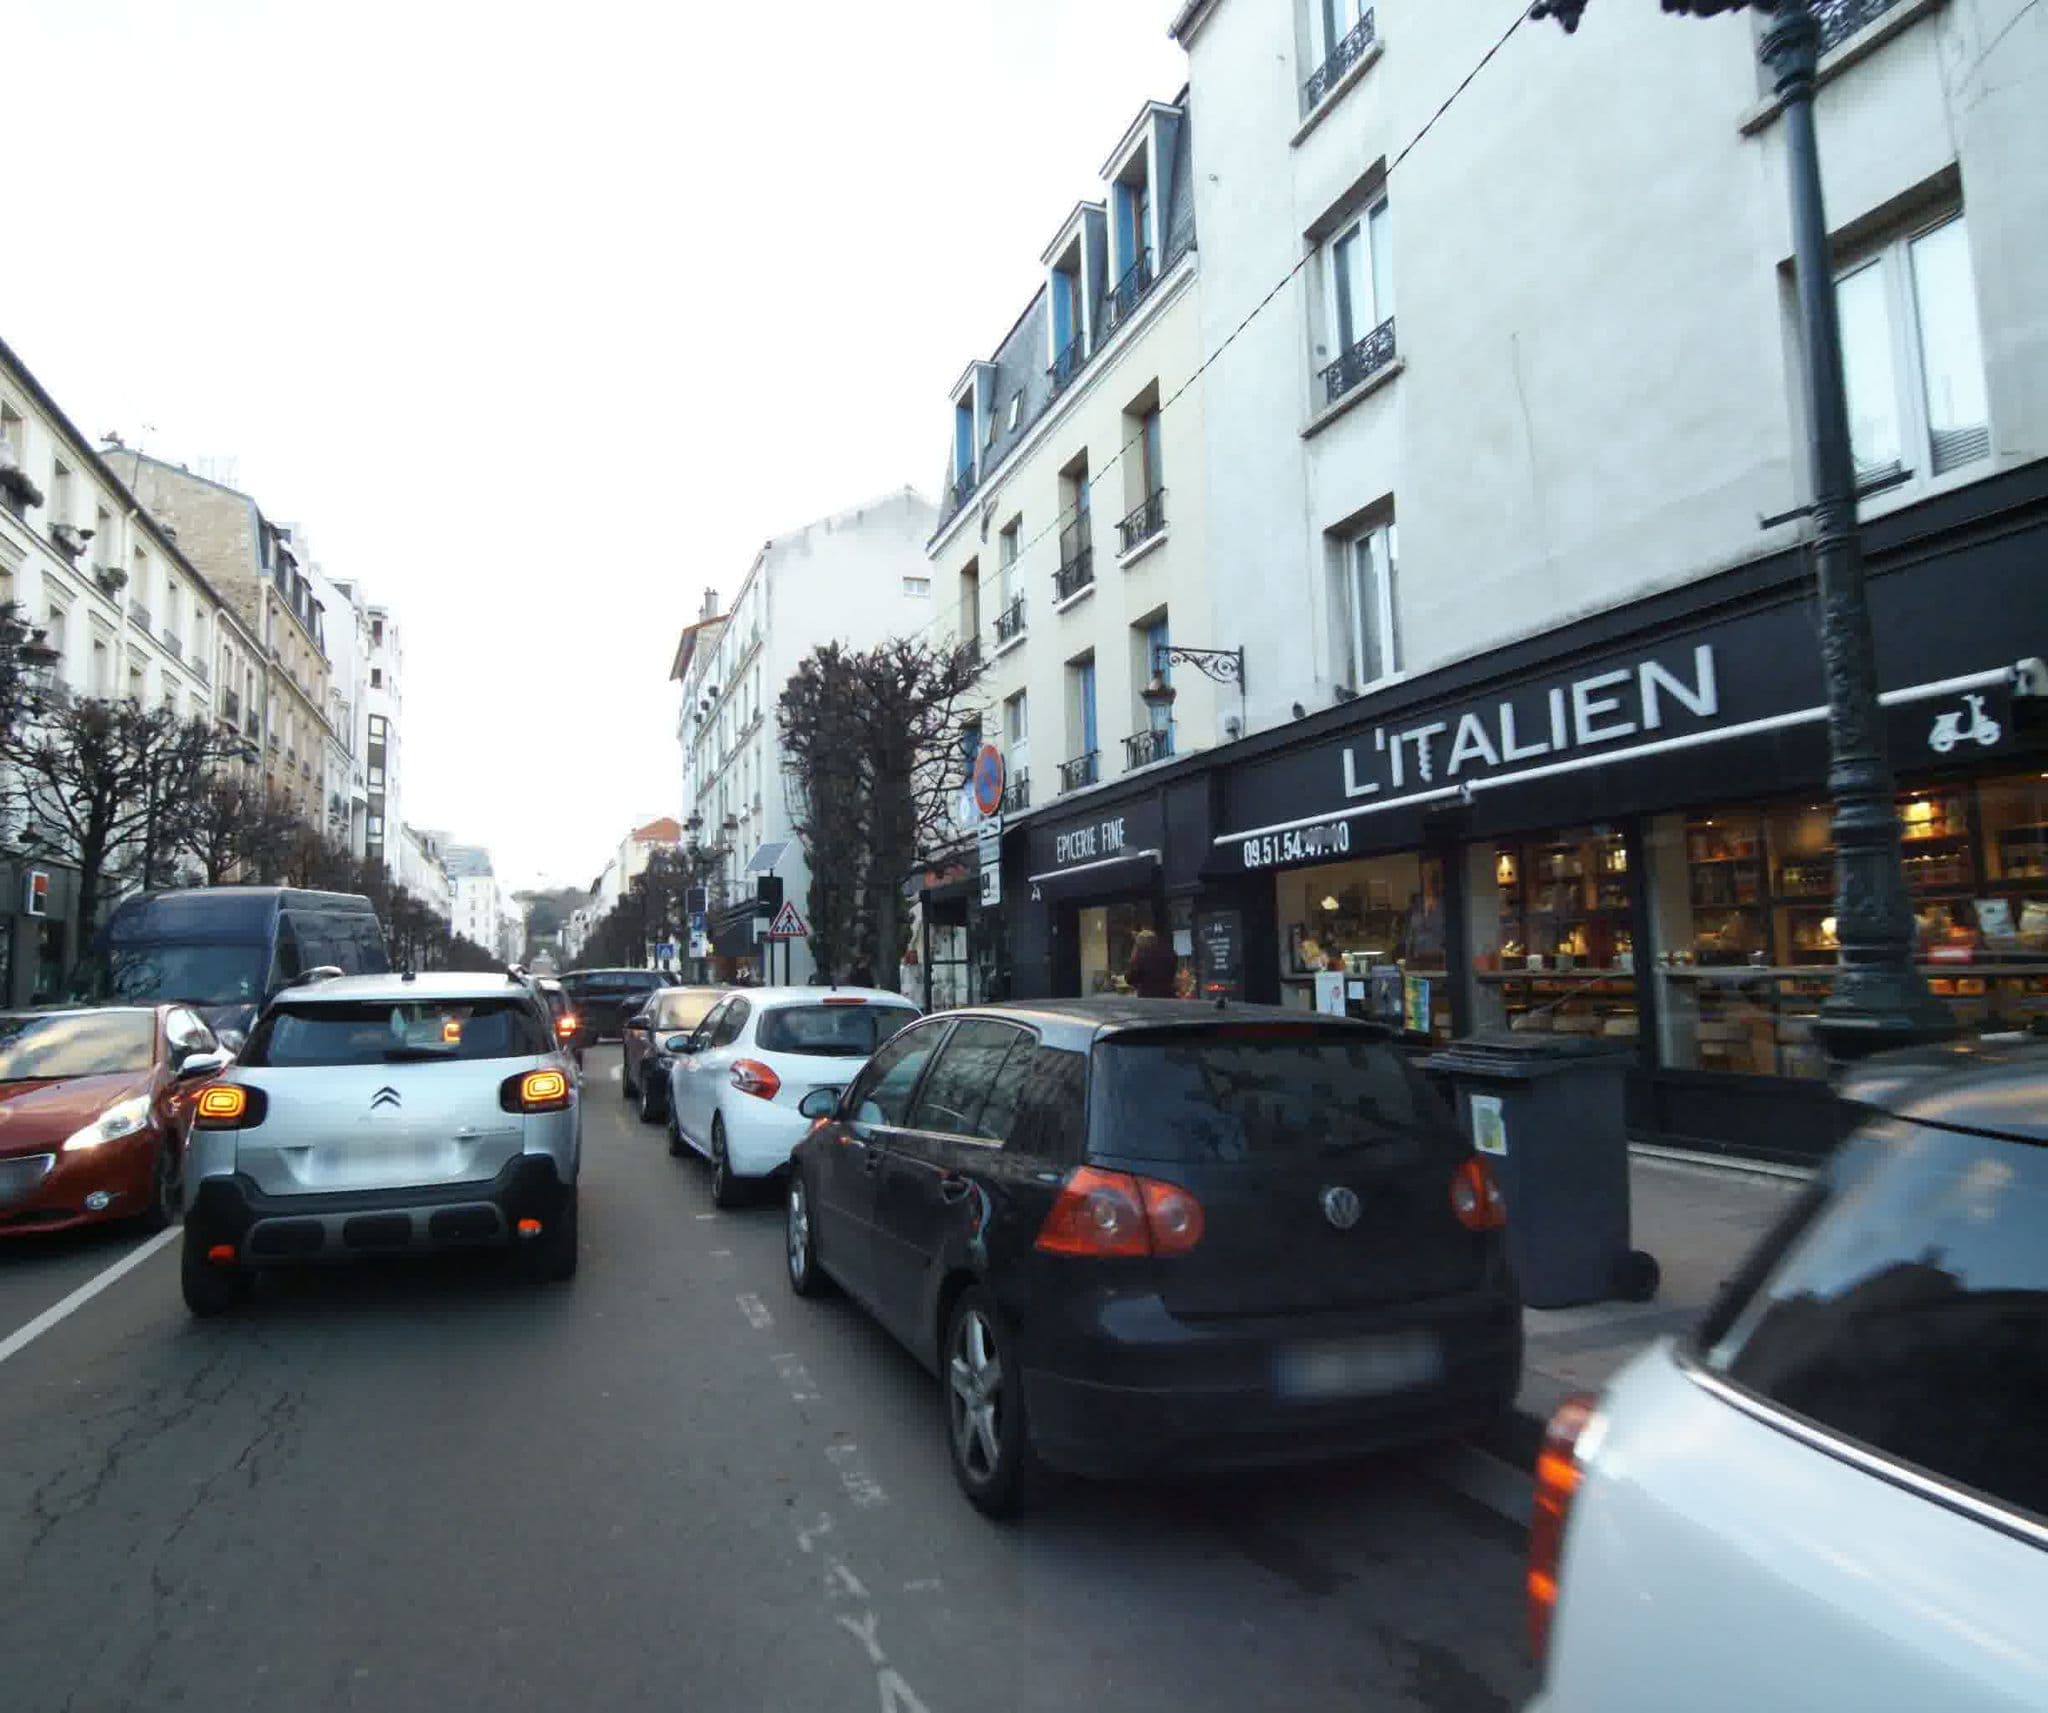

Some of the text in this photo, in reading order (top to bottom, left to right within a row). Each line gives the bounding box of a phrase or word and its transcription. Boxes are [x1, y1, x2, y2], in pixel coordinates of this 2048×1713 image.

[1342, 644, 1718, 798] L'ITALIEN
[1057, 817, 1125, 863] EPICERIE FINE
